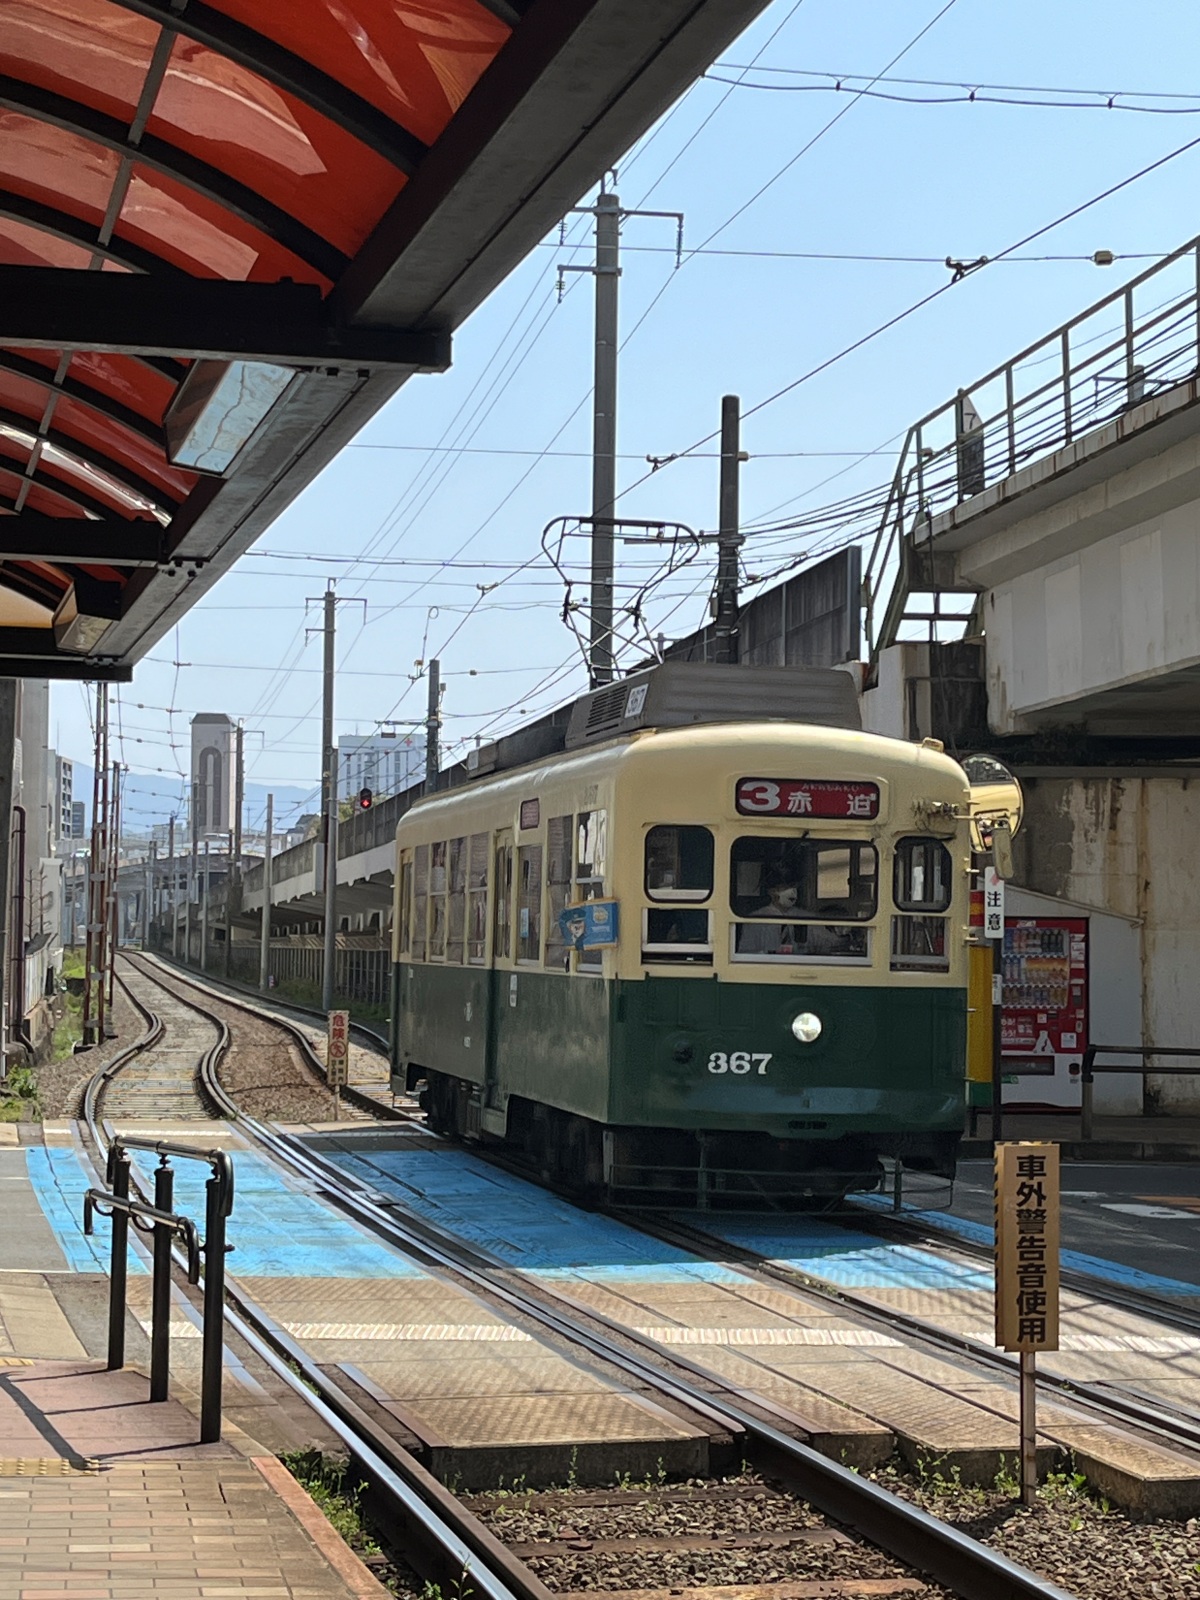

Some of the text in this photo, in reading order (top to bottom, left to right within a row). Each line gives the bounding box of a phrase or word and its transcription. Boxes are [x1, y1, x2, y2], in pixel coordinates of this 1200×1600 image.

[740, 781, 780, 811] 3
[987, 891, 1001, 930] 注意
[708, 1052, 772, 1074] 367
[1016, 1154, 1047, 1344] 車外警告音使用
